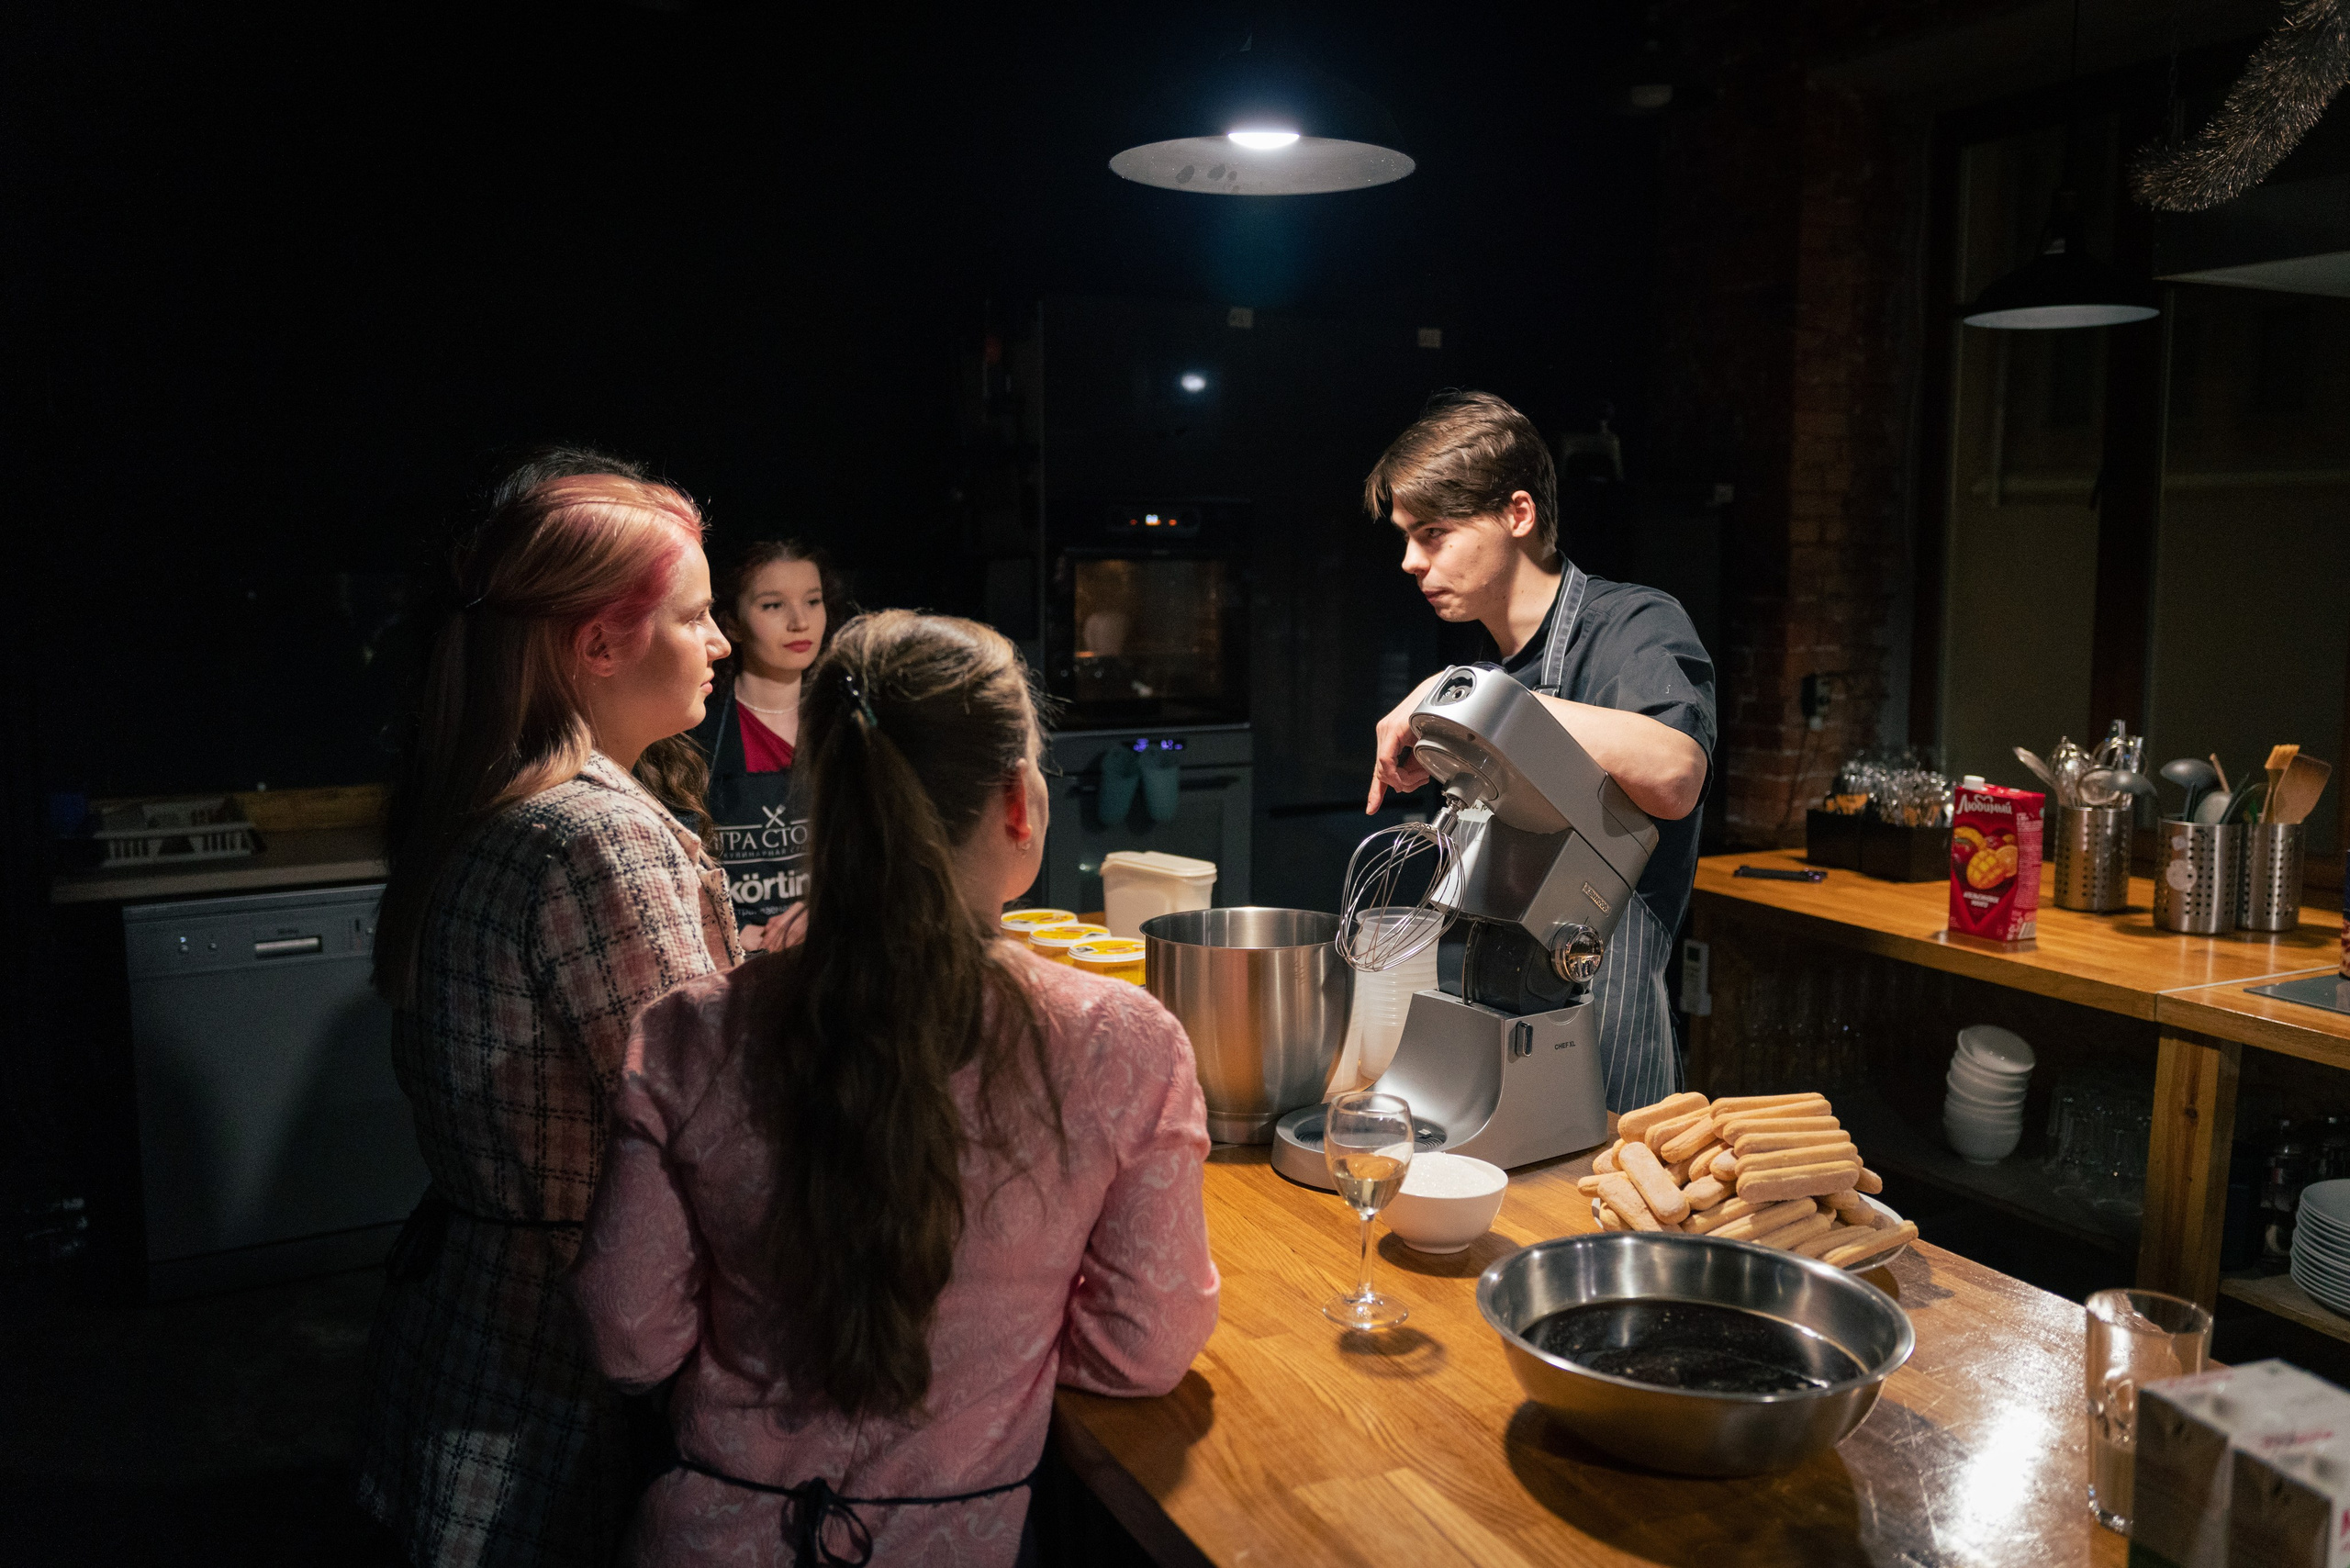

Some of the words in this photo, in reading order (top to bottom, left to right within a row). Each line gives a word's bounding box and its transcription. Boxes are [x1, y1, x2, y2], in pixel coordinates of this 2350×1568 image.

[1955, 793, 2012, 815] Любимый
[1585, 886, 1609, 913] KENWOOD
[1554, 1041, 1569, 1050] CHEF
[1569, 1040, 1576, 1048] XL
